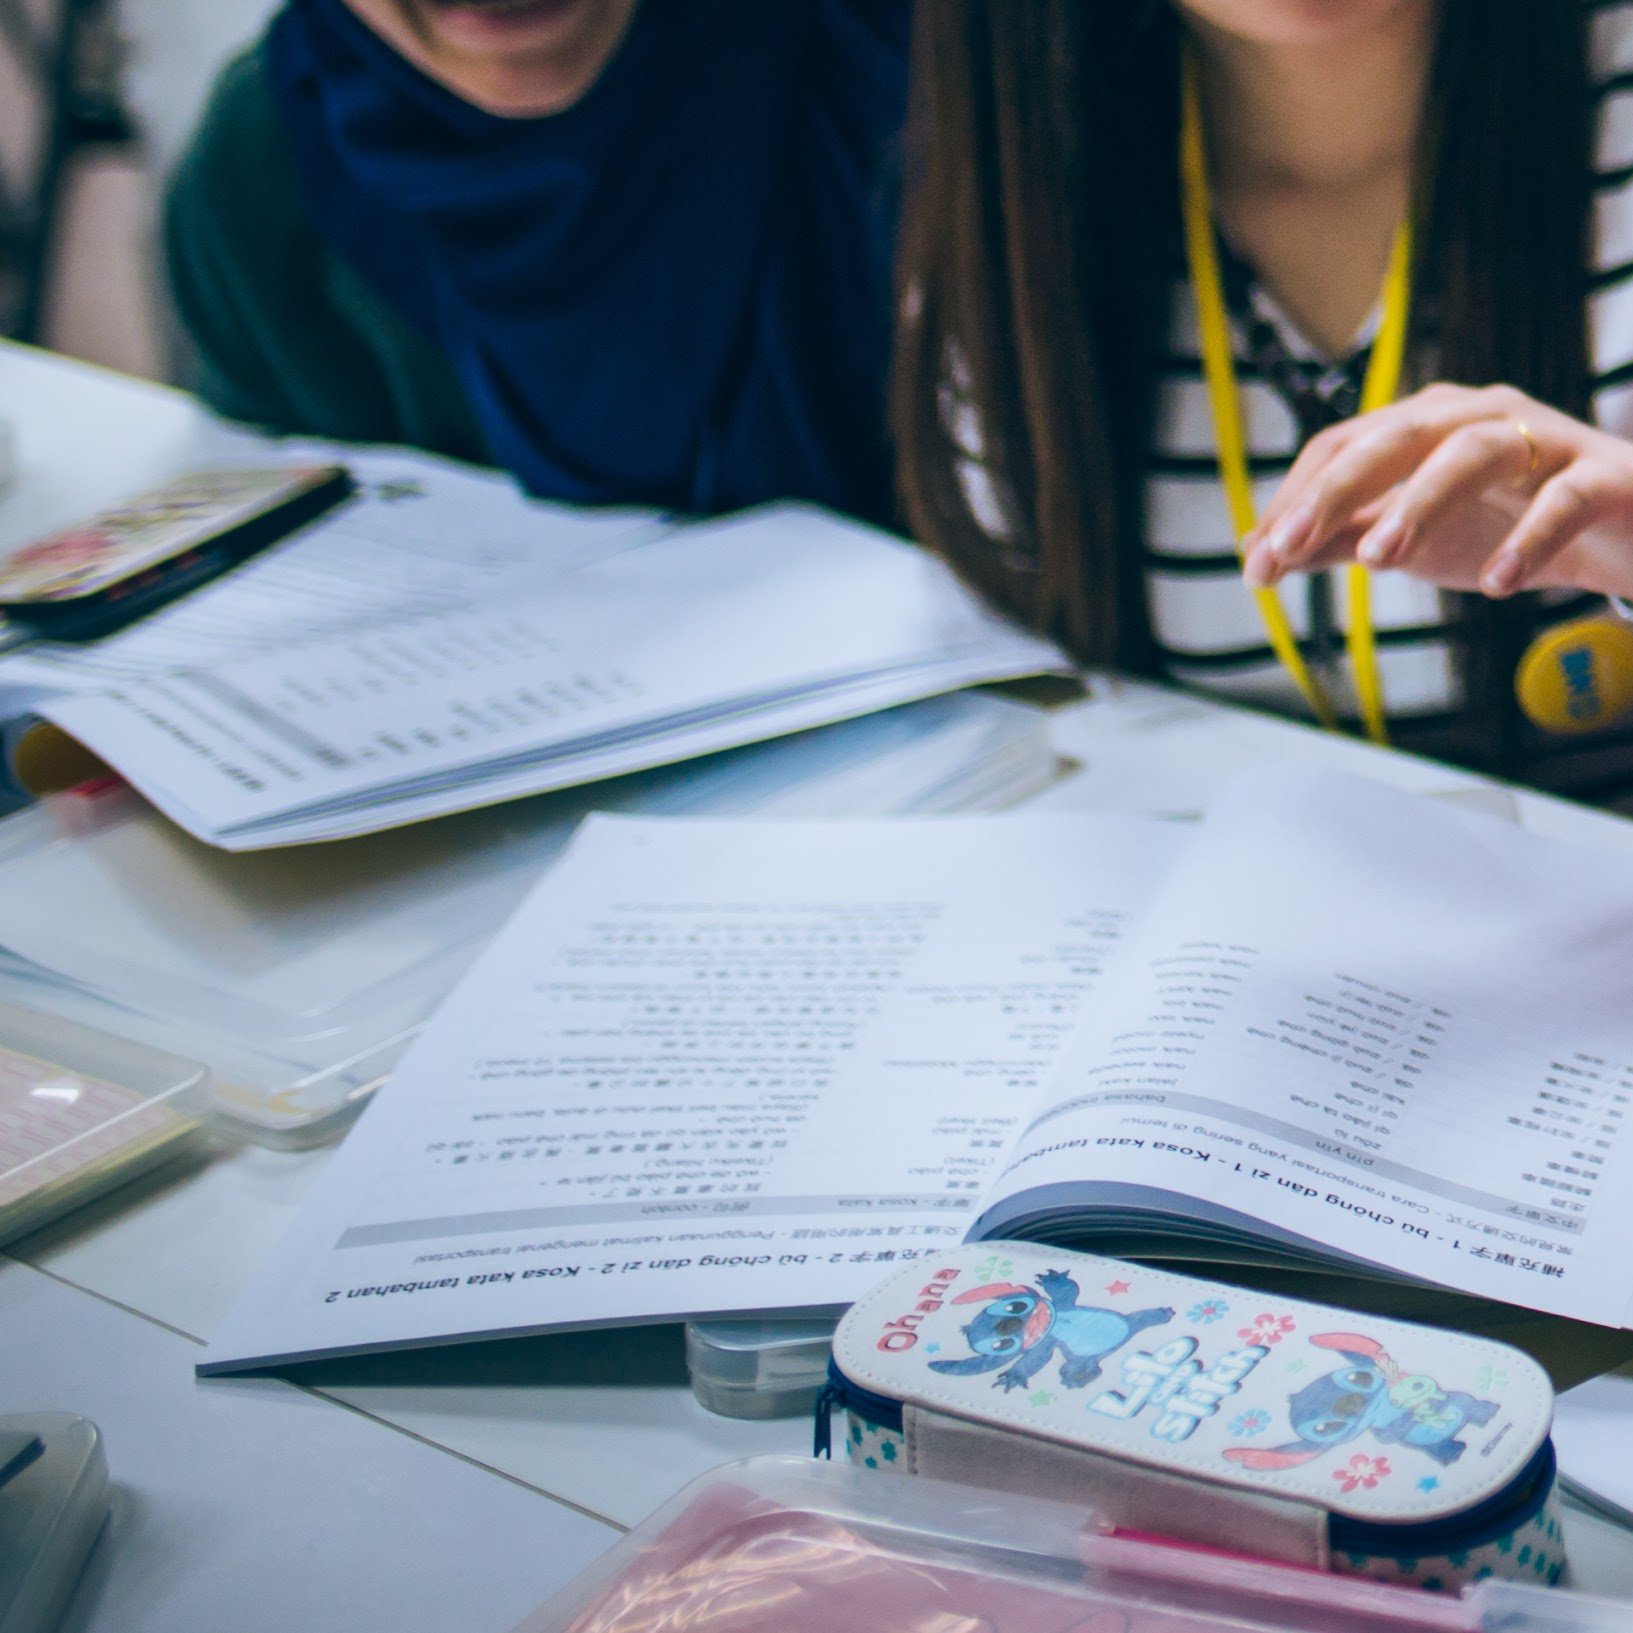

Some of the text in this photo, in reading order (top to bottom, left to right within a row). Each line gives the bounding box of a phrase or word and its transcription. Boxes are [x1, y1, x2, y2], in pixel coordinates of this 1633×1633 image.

[1171, 1122, 1189, 1132] di
[1191, 1125, 1245, 1147] sering
[1095, 1136, 1145, 1150] kata
[1151, 1140, 1211, 1163] Kosa
[1246, 1141, 1288, 1163] yang
[1290, 1158, 1387, 1200] transportasi
[1390, 1193, 1431, 1215] Cara
[1504, 1204, 1579, 1230] 中文單字
[1452, 1239, 1461, 1250] 1
[600, 1262, 617, 1276] 2
[828, 1252, 845, 1264] 2
[1469, 1245, 1565, 1279] 補充單字
[465, 1271, 516, 1287] kata
[520, 1265, 582, 1280] Kosa
[323, 1290, 342, 1305] 2
[345, 1276, 461, 1300] tambahan
[876, 1268, 962, 1354] Ohana
[1086, 1335, 1200, 1421] Lilo
[1150, 1344, 1271, 1443] Stitch
